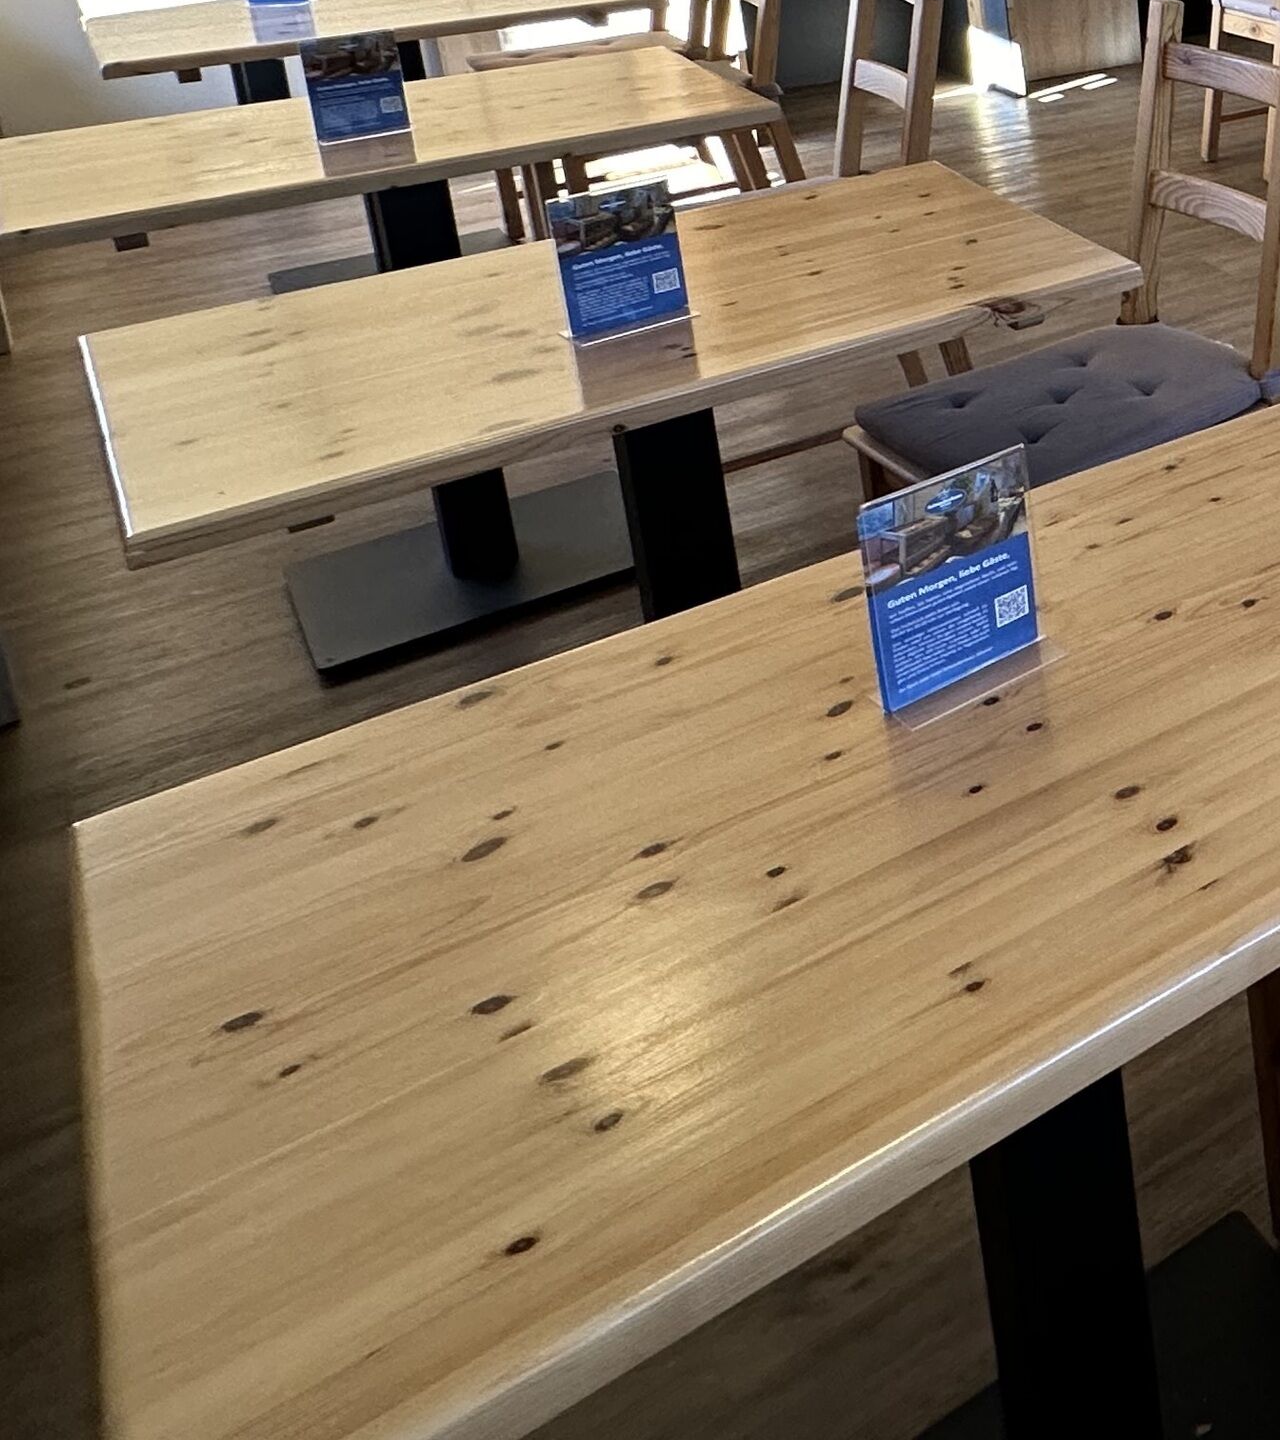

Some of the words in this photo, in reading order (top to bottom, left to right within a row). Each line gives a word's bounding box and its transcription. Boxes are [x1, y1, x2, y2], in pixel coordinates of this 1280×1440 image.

[887, 592, 918, 609] Guten
[918, 575, 958, 596] Morgen,
[959, 564, 982, 578] liebe
[982, 552, 1010, 568] Gäste,
